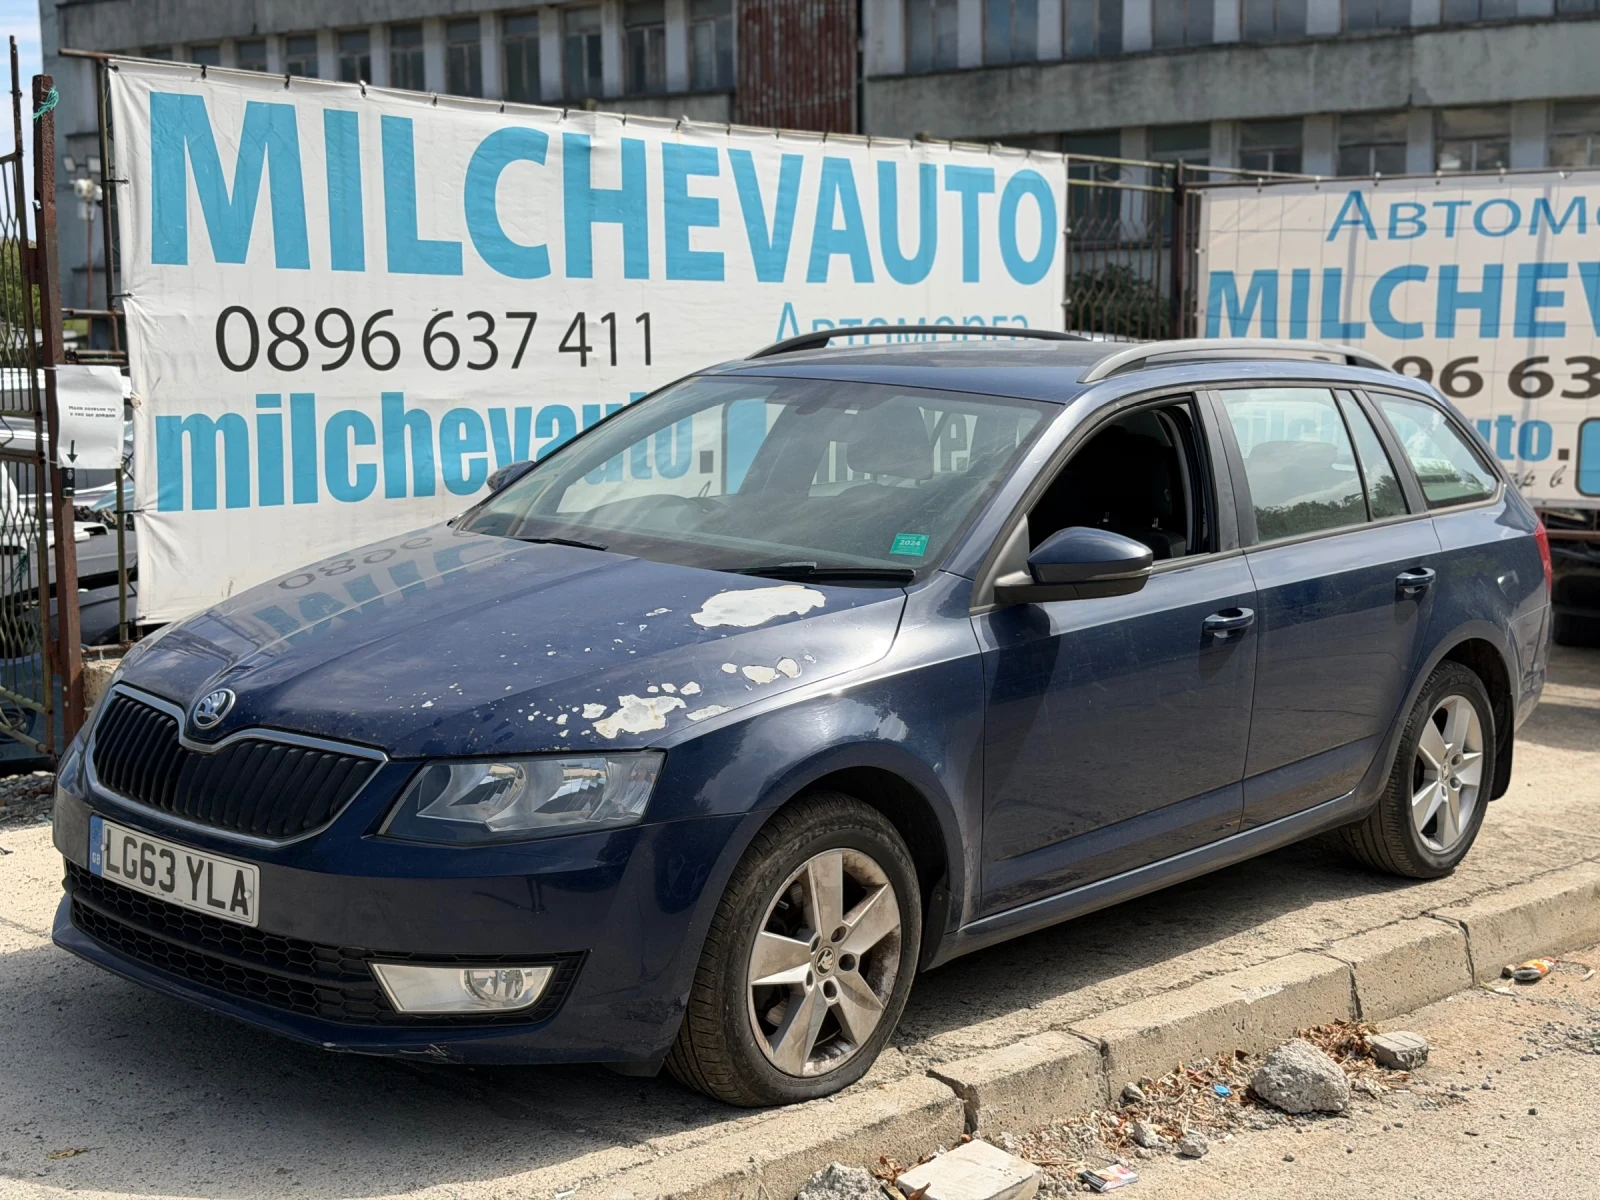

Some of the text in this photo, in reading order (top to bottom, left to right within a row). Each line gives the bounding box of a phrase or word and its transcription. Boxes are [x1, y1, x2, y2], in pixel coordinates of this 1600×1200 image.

[149, 91, 1058, 286] MILCHEVAUTO
[1327, 190, 1600, 241] Автом
[215, 305, 652, 372] 0896 637 411
[92, 852, 101, 865] GB
[106, 828, 249, 916] LG63 YLA
